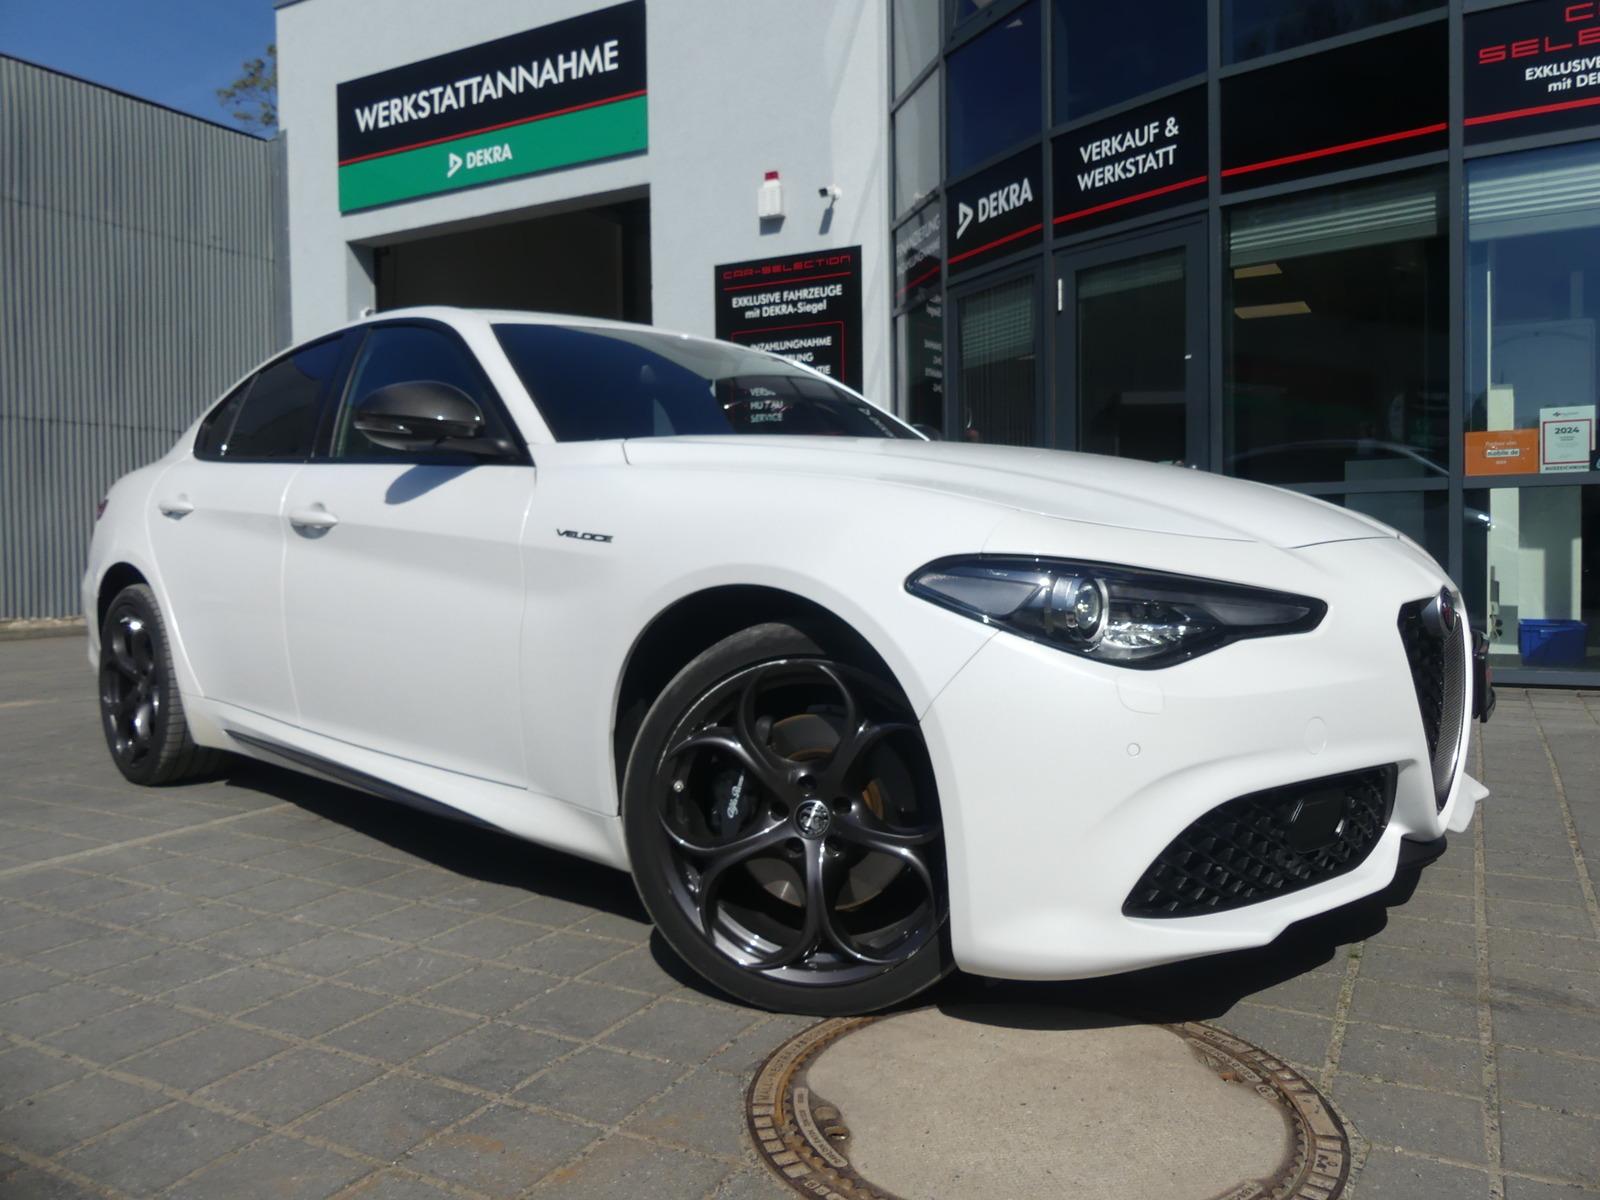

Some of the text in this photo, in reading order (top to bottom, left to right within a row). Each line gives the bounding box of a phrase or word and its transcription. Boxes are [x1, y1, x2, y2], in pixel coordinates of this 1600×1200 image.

[1565, 2, 1600, 22] C
[1524, 55, 1600, 81] EXKLUSIVE
[355, 39, 620, 133] WERKSTATTANNAHME
[1547, 77, 1572, 92] mit
[1079, 116, 1179, 165] VERKAUF &
[465, 143, 513, 170] DEKRA
[1077, 144, 1177, 192] WERKSTATT
[977, 177, 1033, 223] DEKRA
[731, 284, 843, 309] EXKLUSIVE FAHRZEUGE
[744, 299, 828, 319] mit DEKRA-Siegel
[1554, 426, 1580, 435] 2024
[556, 528, 613, 544] VELOCE
